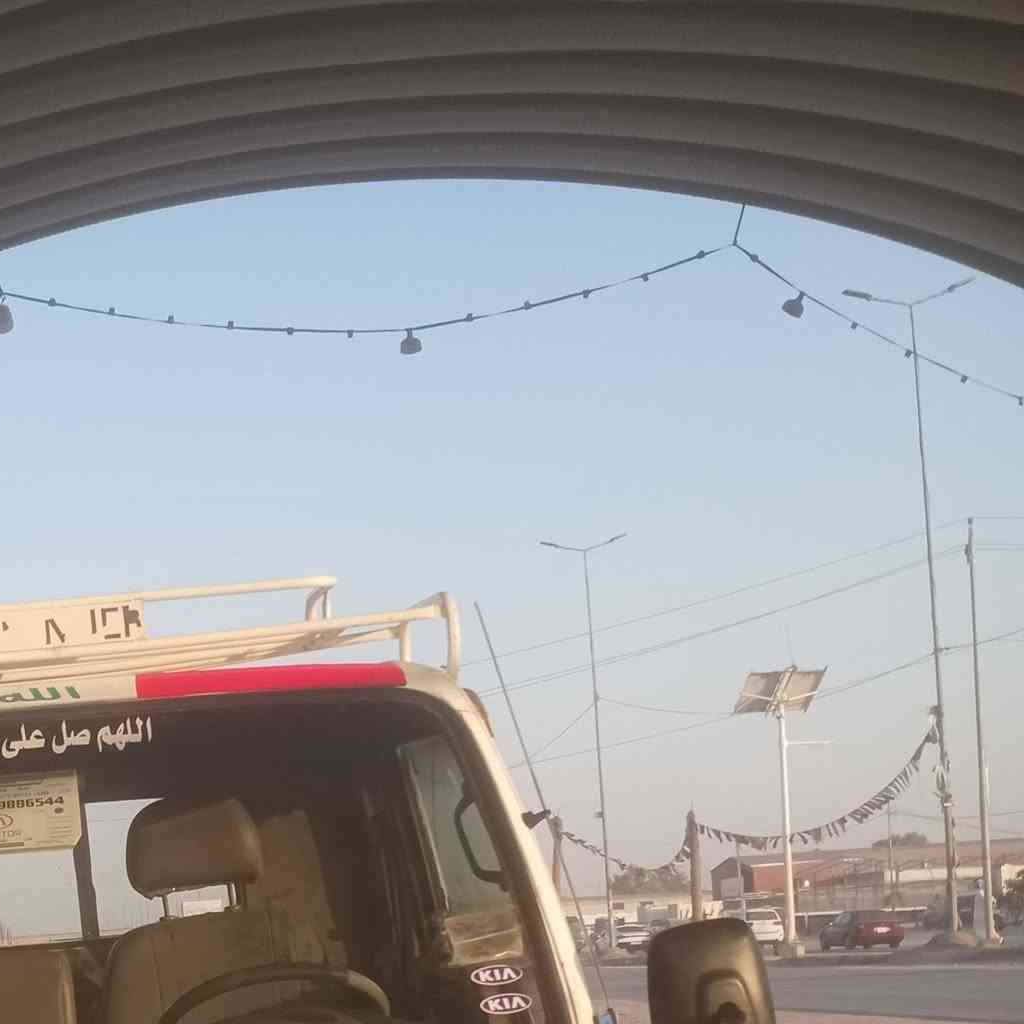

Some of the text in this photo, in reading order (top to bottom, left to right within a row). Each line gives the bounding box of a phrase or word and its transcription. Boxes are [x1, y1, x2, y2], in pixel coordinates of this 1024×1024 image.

[1, 723, 46, 759] على
[51, 719, 91, 754] صل
[97, 716, 153, 752] اللهم
[477, 966, 518, 983] KIA
[487, 995, 527, 1012] KIA
